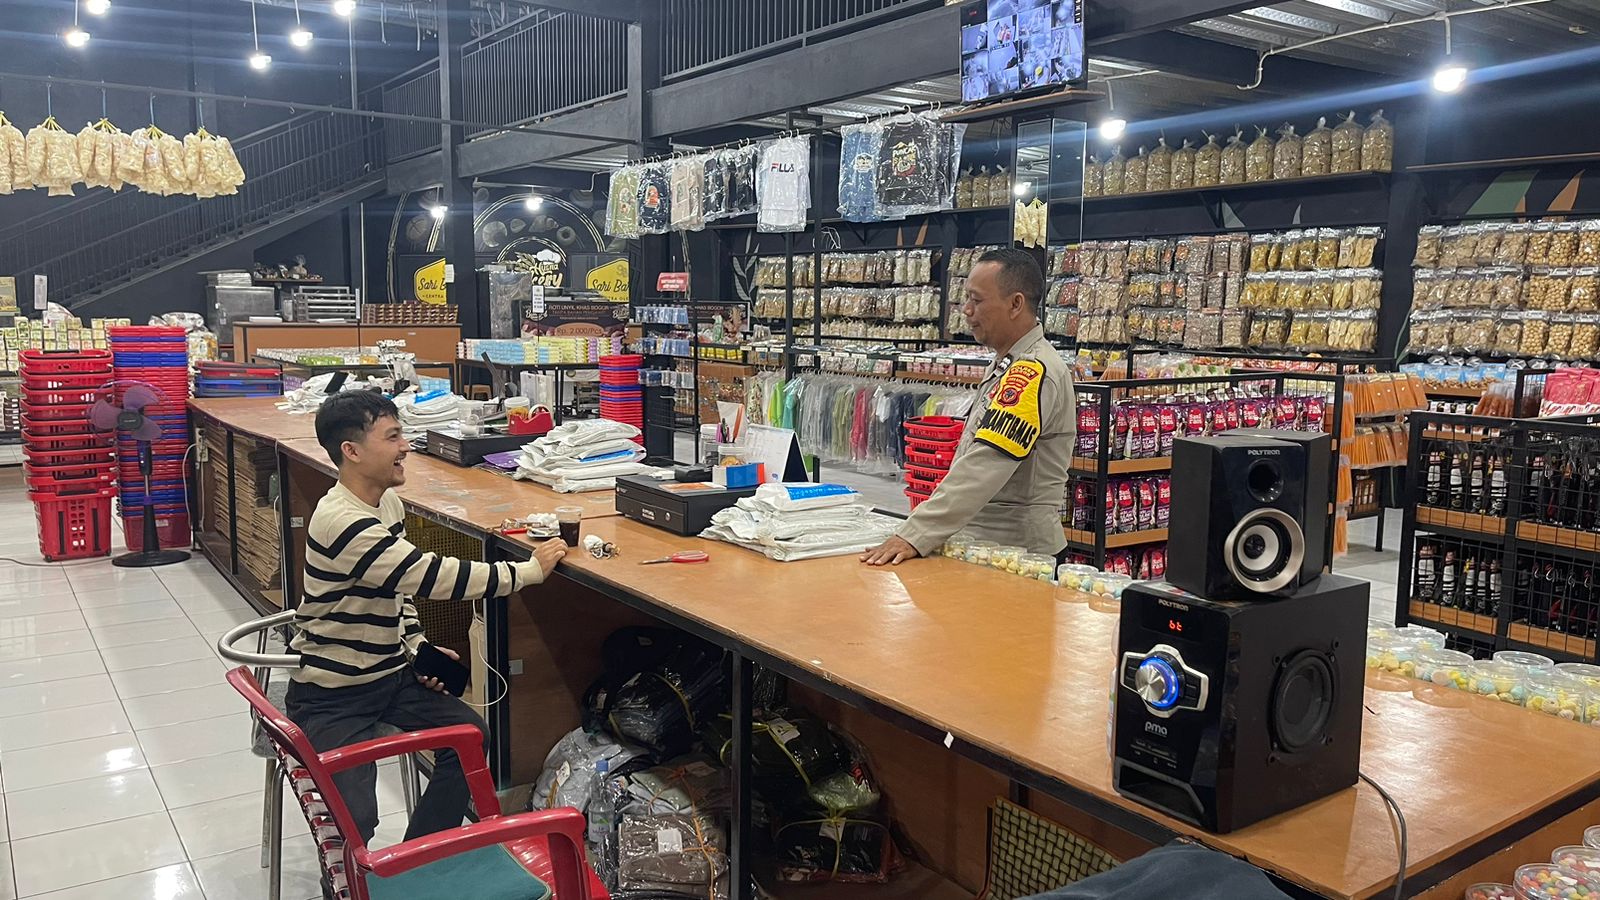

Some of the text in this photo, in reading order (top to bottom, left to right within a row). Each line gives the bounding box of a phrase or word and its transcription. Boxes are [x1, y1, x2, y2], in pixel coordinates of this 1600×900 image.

[1158, 599, 1189, 612] POLYTRON
[1169, 620, 1182, 632] bt
[1144, 721, 1168, 735] pma
